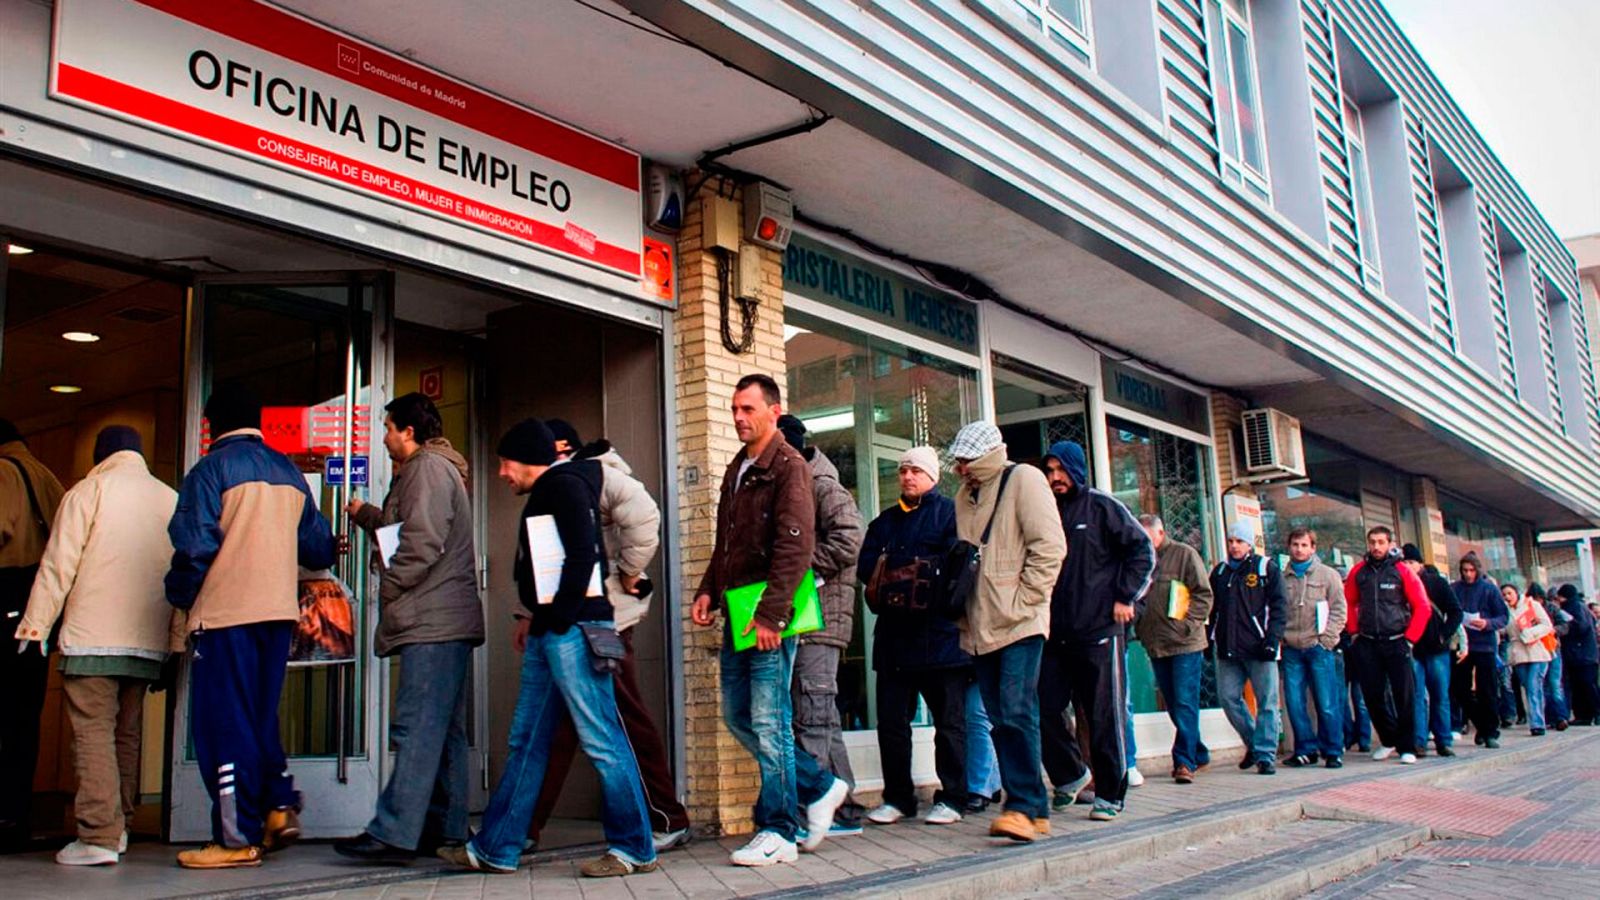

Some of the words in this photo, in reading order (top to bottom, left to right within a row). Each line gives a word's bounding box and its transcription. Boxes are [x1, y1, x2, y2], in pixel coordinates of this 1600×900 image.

[188, 50, 365, 143] OFICINA
[378, 115, 426, 164] DE
[439, 137, 571, 212] EMPLEO
[363, 61, 417, 90] Comunidad
[420, 85, 432, 96] de
[434, 89, 466, 109] Madrid
[257, 137, 339, 172] CONSEJERÍA
[342, 164, 359, 178] DE
[362, 170, 413, 198] EMPLEO,
[415, 188, 453, 210] MUJER
[456, 202, 463, 214] E
[465, 205, 533, 235] INMIGRACIÓN
[783, 243, 895, 317] RISTALERIA
[904, 288, 976, 345] MENESES
[330, 466, 365, 475] EMUJE
